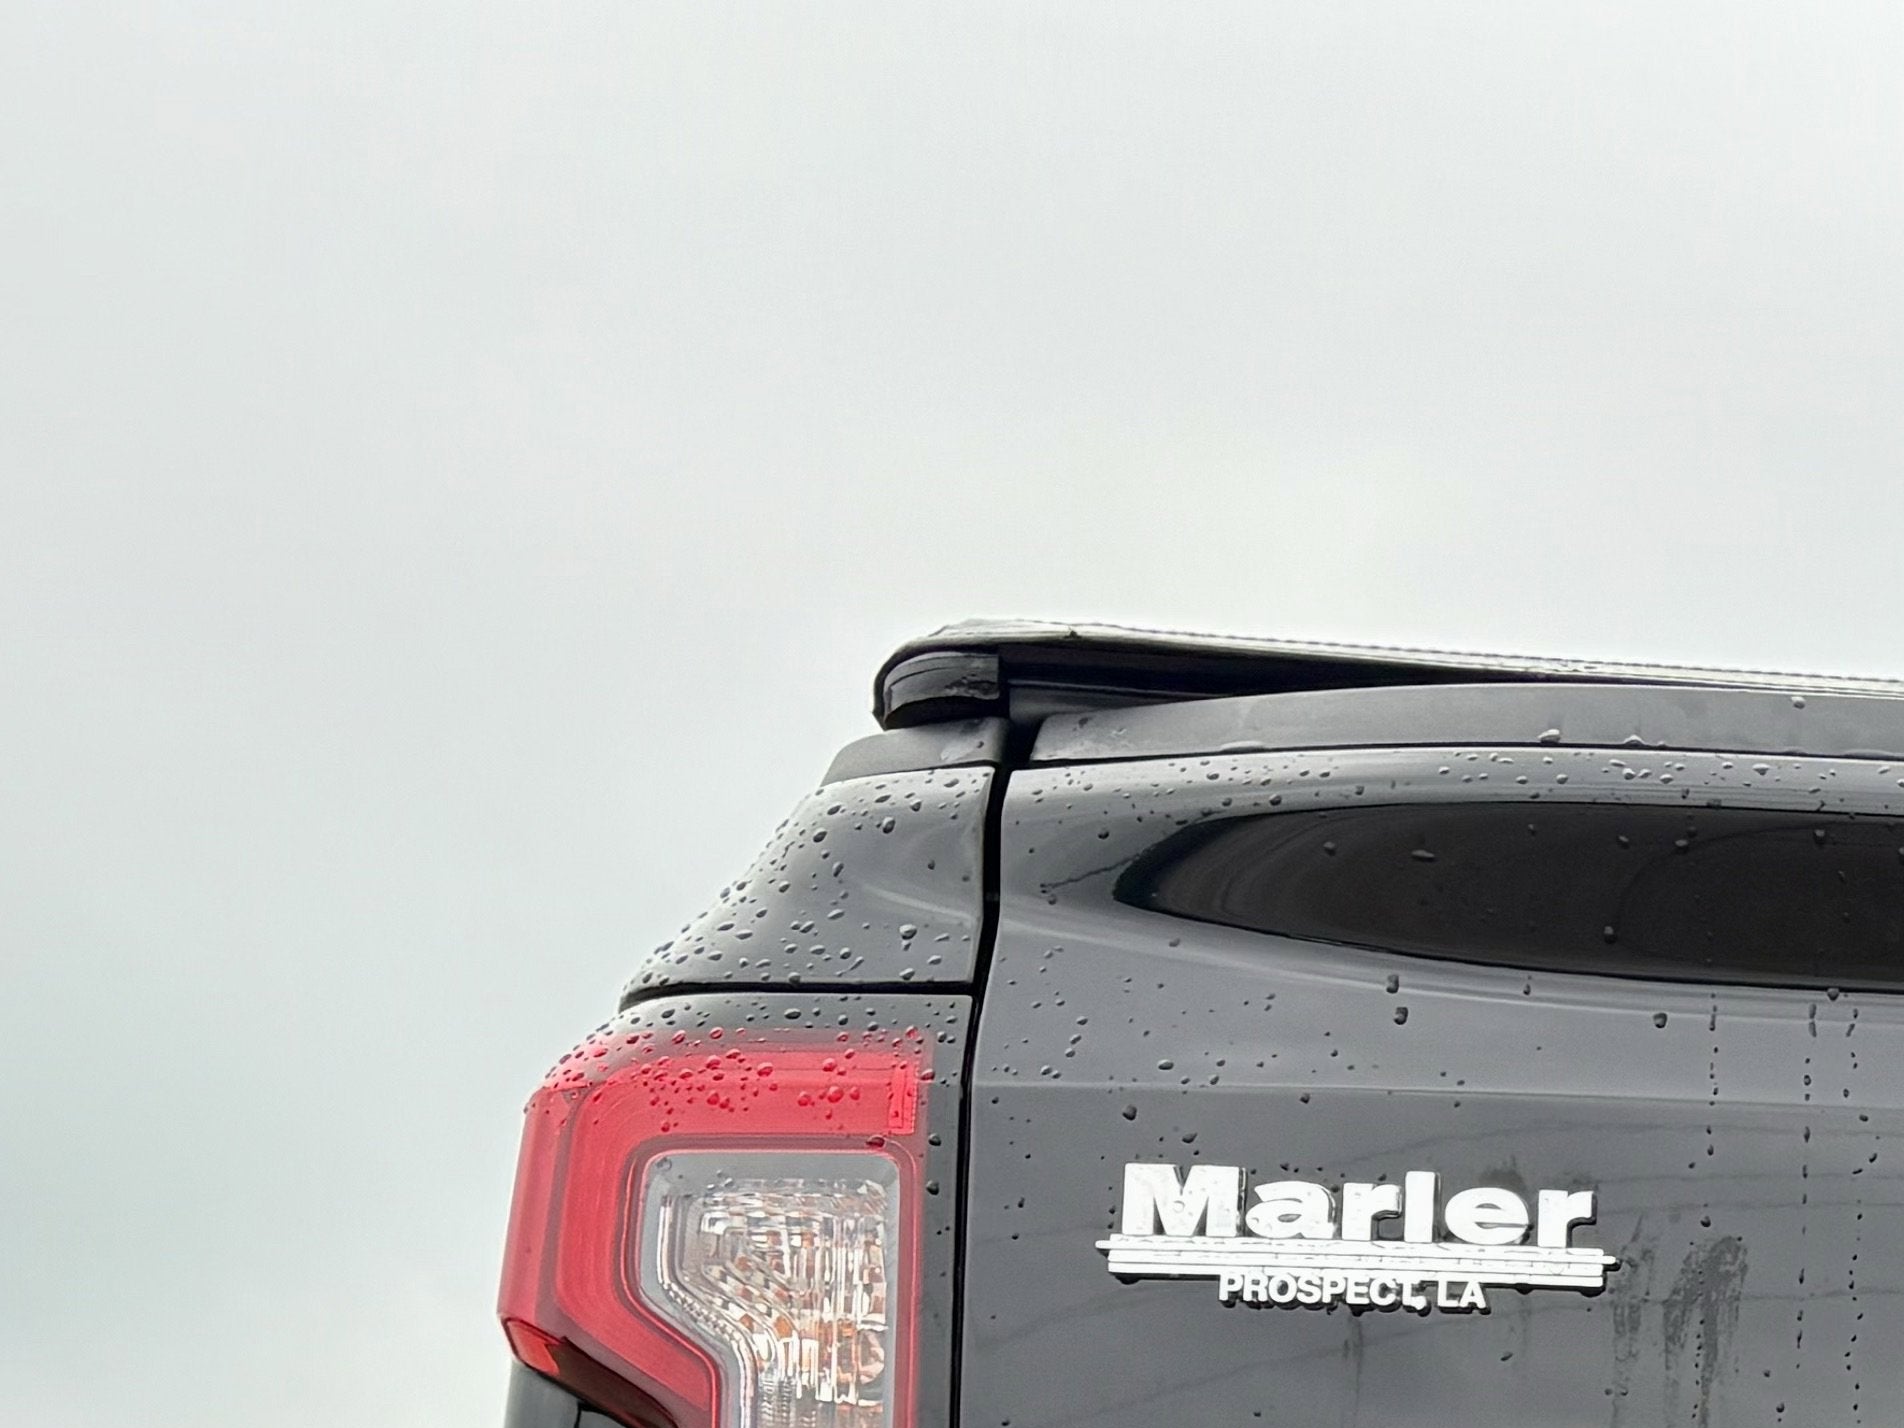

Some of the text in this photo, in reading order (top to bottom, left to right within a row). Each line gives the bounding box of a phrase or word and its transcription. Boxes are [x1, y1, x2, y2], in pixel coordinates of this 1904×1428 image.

[1121, 1163, 1598, 1248] Marler
[1219, 1274, 1487, 1310] PROSPECT, LA
